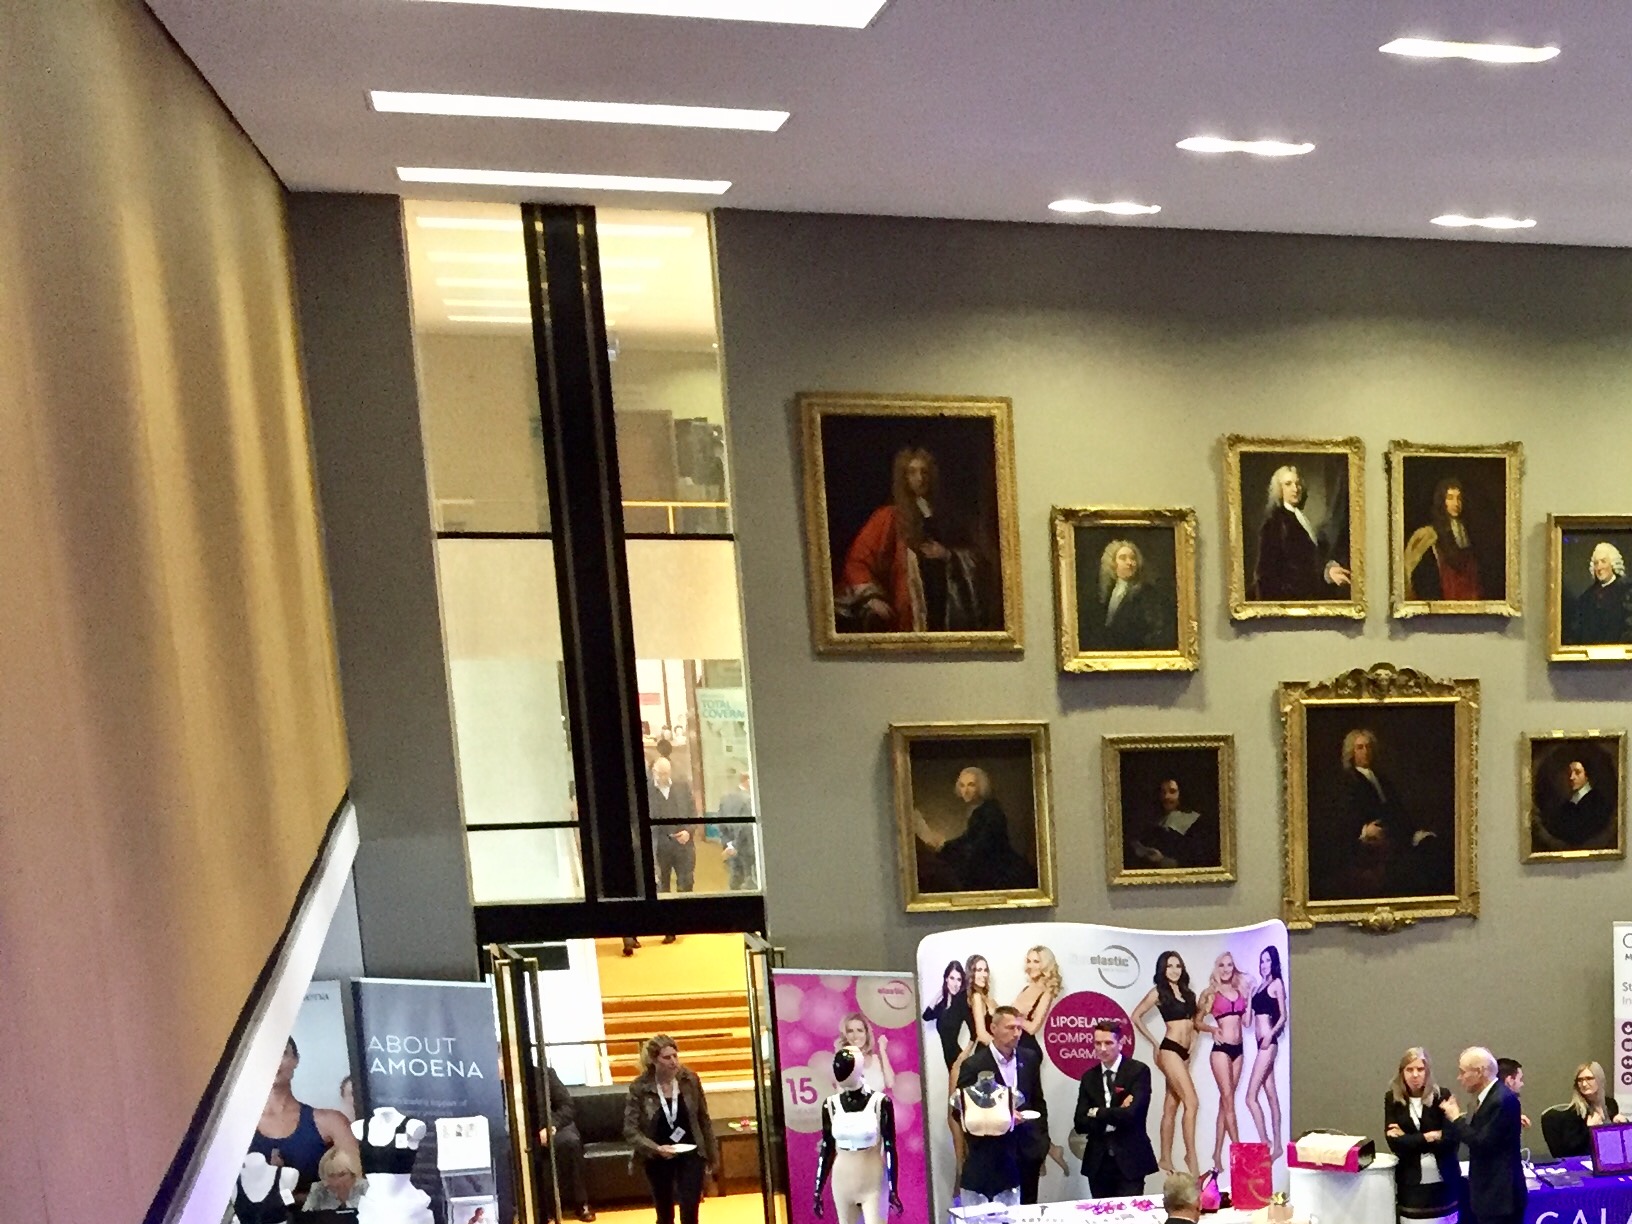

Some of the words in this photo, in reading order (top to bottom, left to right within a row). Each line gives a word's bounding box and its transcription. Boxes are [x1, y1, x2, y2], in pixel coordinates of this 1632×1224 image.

[368, 1035, 456, 1055] ABOUT
[370, 1057, 484, 1079] AMOENA
[786, 1077, 818, 1105] 15
